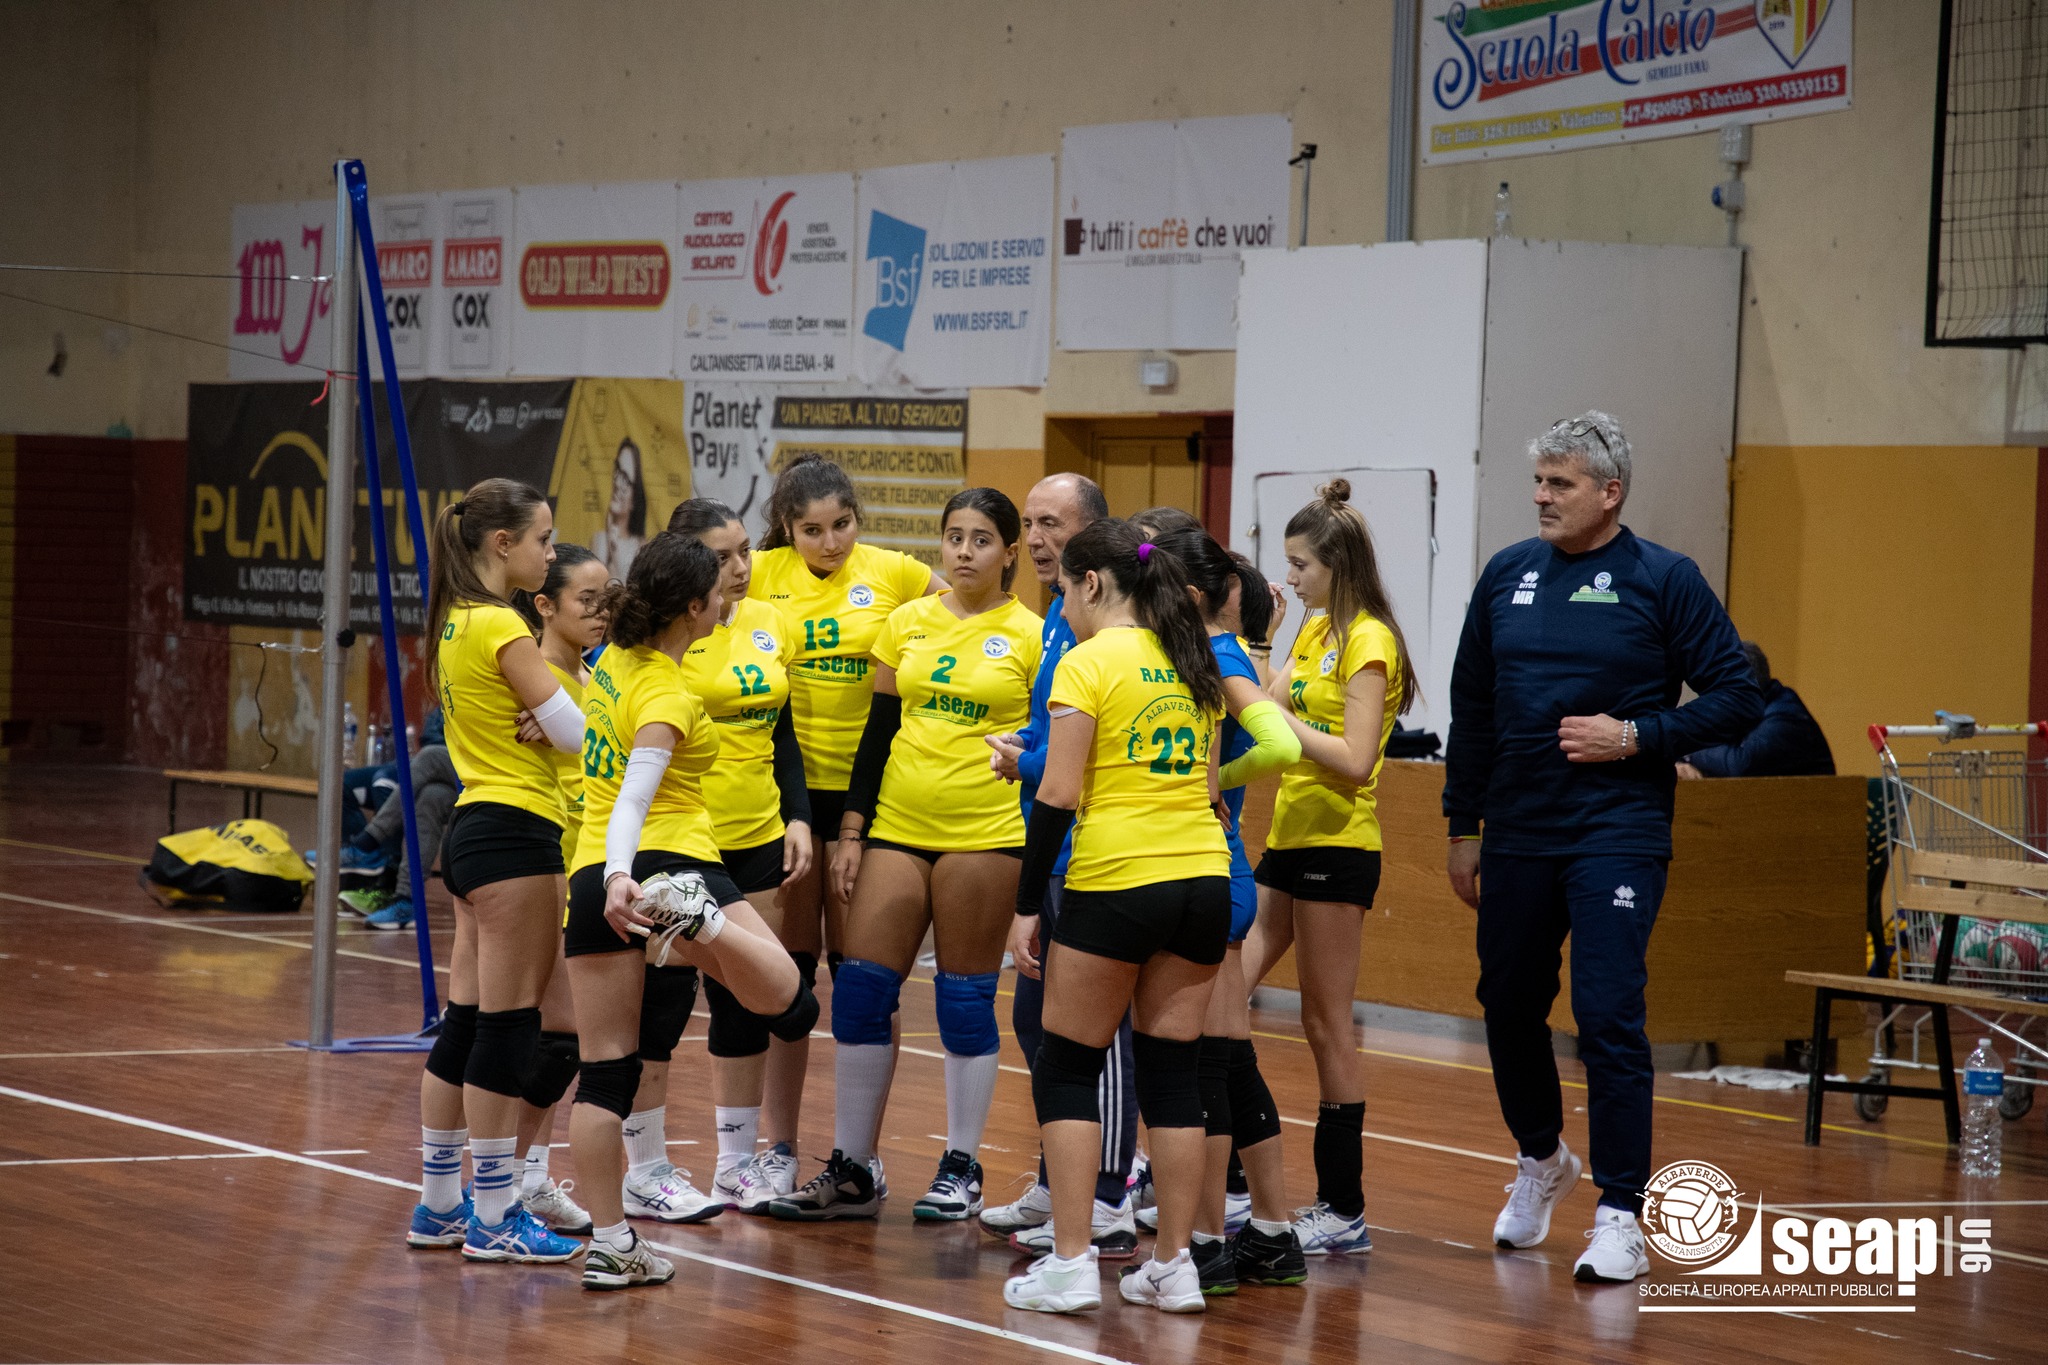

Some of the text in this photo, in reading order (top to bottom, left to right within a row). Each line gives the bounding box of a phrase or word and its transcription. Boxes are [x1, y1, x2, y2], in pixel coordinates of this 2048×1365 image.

[1433, 0, 1716, 110] Scuola Calcio
[1699, 87, 1754, 110] Fabrizio
[1755, 73, 1840, 104] 320.9339113
[694, 211, 732, 226] CENTRO
[684, 232, 745, 248] AUDIOLOGICO
[1090, 221, 1125, 251] tutti
[1137, 217, 1188, 250] caffè
[1195, 216, 1226, 248] che
[1232, 215, 1273, 247] vuoi
[992, 241, 998, 258] E
[1001, 238, 1046, 259] SERVIZI
[447, 248, 498, 279] AMARO
[526, 254, 664, 296] OLD WILD WEST
[691, 255, 736, 270] SICILIANO
[876, 253, 920, 308] Bsf
[932, 266, 1031, 288] PER LE IMPRESE
[384, 294, 421, 328] COX
[452, 292, 490, 328] COX
[933, 310, 1029, 331] WWW.BSFSRL.IT
[690, 353, 764, 372] CALTANISSETTA
[766, 353, 781, 371] VIA
[783, 353, 815, 371] ELENA
[823, 353, 835, 371] 94
[691, 392, 762, 430] Planet
[781, 402, 963, 427] UN PIANETA AL TUO SERVIZIO
[691, 432, 730, 478] Pay
[847, 450, 913, 471] RICARICHE
[249, 567, 295, 593] NOSTRO
[298, 569, 325, 594] GIOC
[390, 572, 422, 599] LTRO
[1511, 590, 1535, 604] MR
[804, 617, 840, 650] 13
[732, 663, 771, 696] 12
[818, 655, 869, 677] seap
[930, 654, 957, 684] 2
[939, 694, 989, 721] seap
[1145, 701, 1205, 723] ALBAVERDE
[584, 727, 616, 779] 20
[1150, 727, 1196, 775] 23
[1303, 872, 1332, 881] max
[1613, 898, 1635, 909] errea
[438, 1148, 456, 1156] NIKE
[480, 1160, 499, 1168] NIKE
